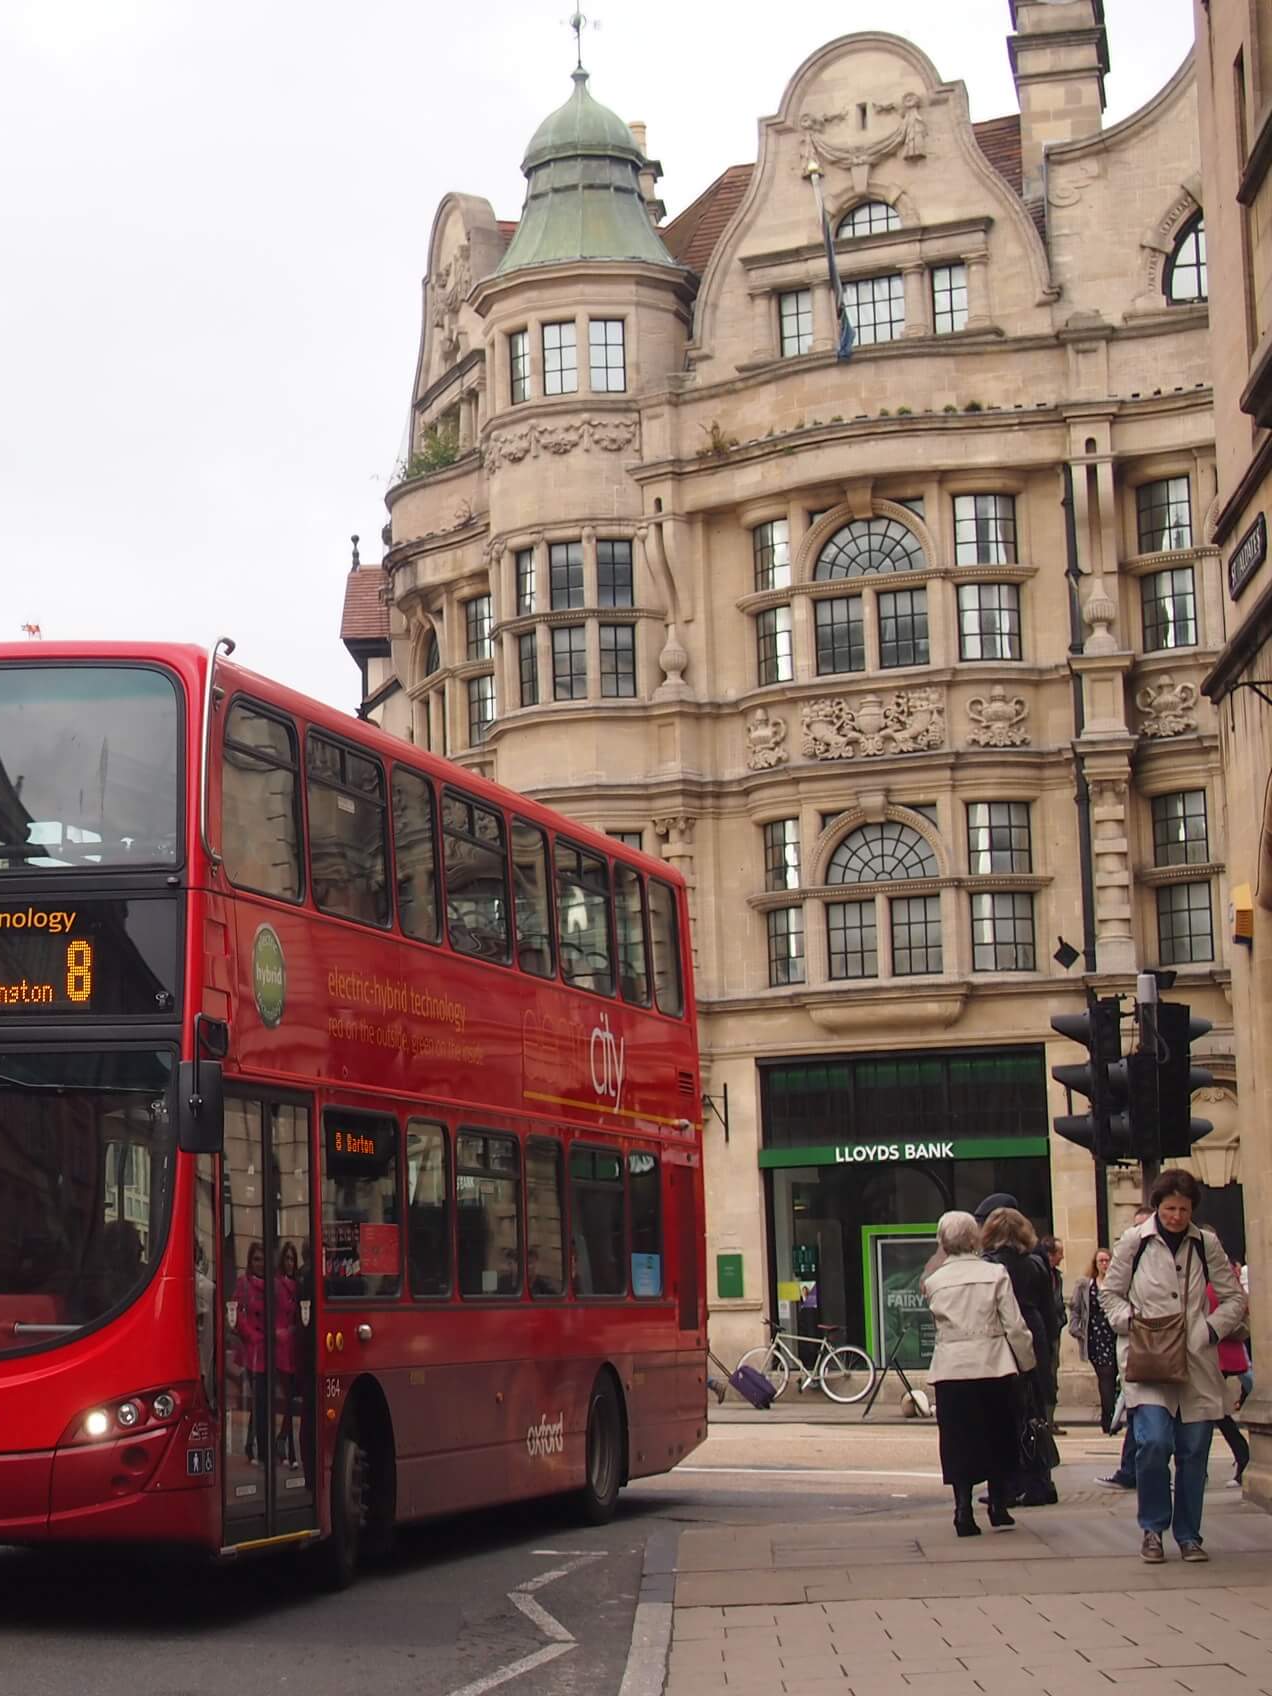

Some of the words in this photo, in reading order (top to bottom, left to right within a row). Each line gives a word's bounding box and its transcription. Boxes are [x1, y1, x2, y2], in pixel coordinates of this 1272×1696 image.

[67, 940, 92, 1001] 8
[256, 961, 283, 985] hybrid
[328, 965, 408, 1017] electric-hybrid
[410, 987, 466, 1033] technology
[328, 1015, 343, 1038] red
[590, 1011, 625, 1114] city
[347, 1133, 375, 1155] Barton
[835, 1144, 900, 1163] LLOYDS
[905, 1142, 954, 1159] BANK
[887, 1294, 925, 1308] FAIRY
[326, 1378, 340, 1398] 364
[527, 1411, 564, 1457] oxford
